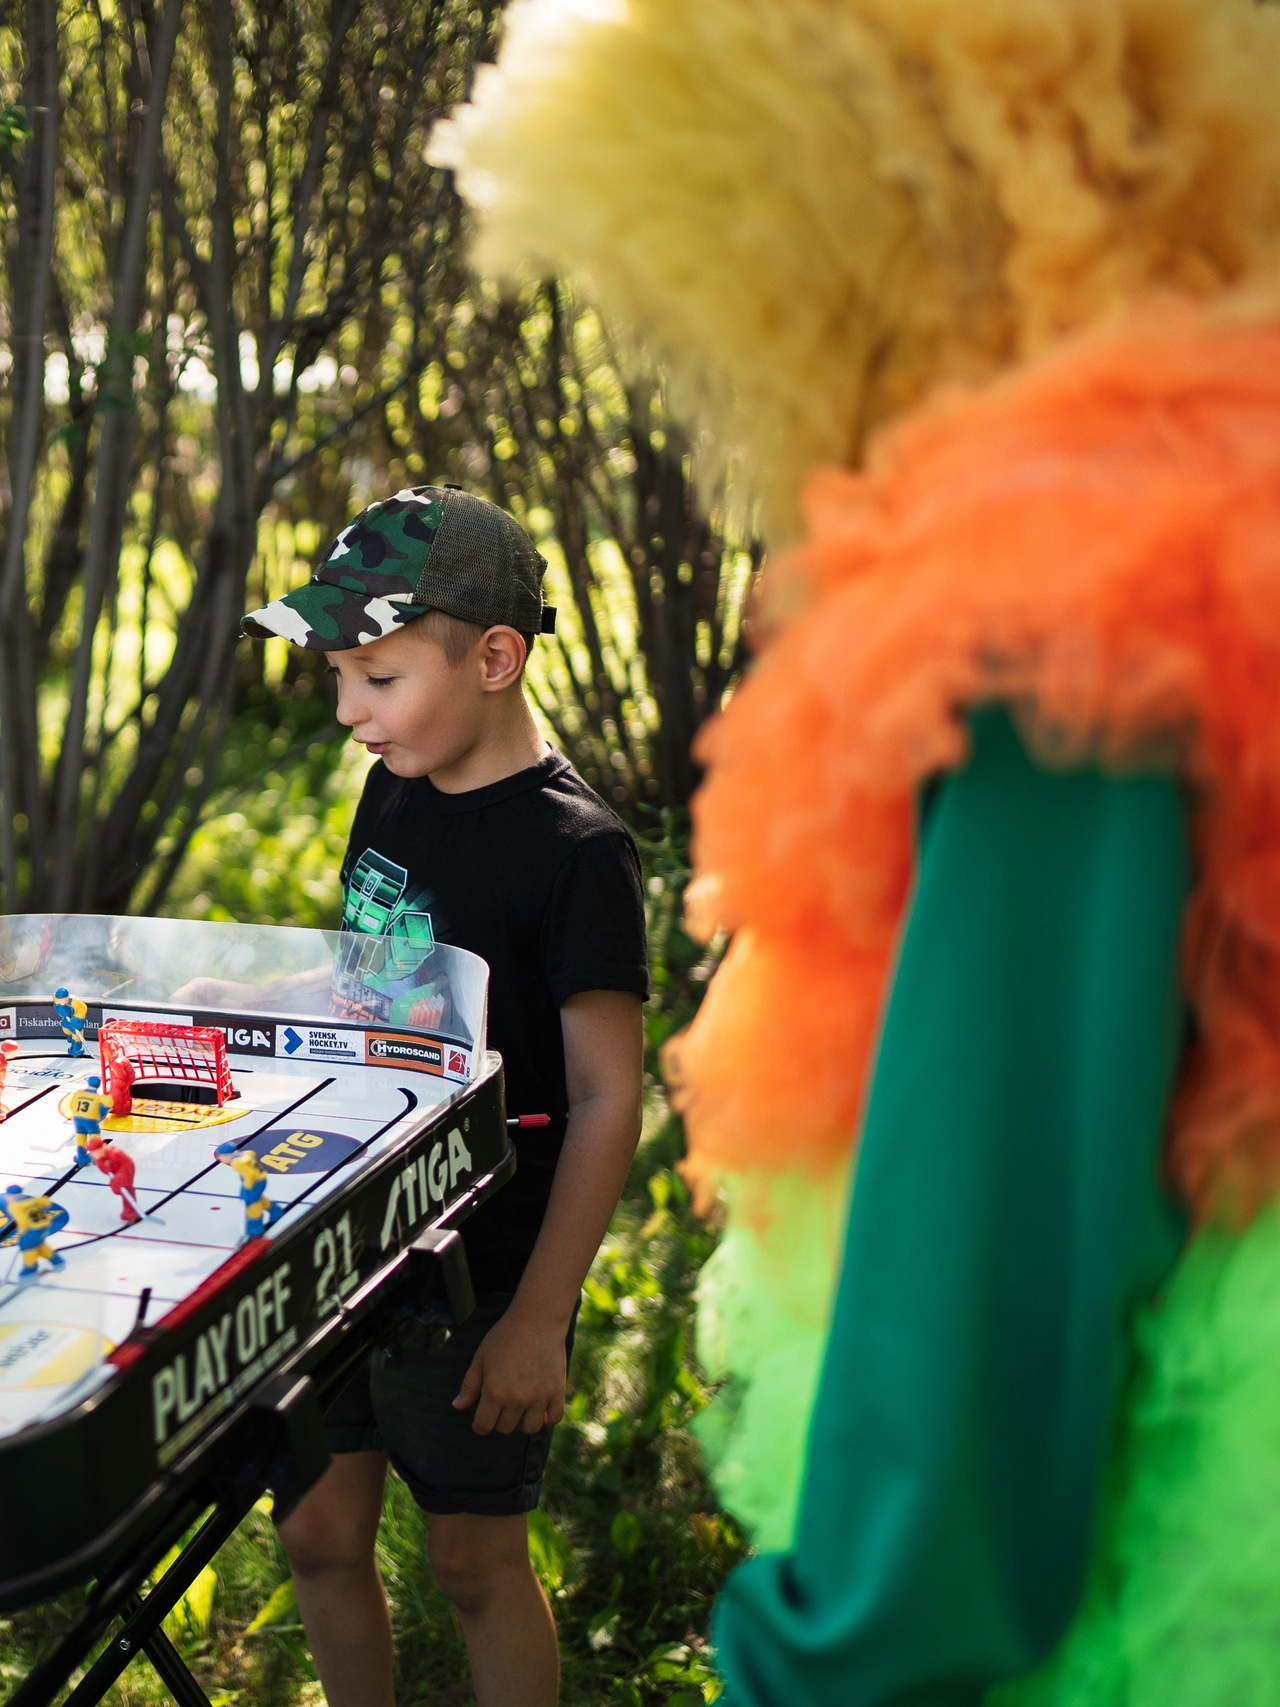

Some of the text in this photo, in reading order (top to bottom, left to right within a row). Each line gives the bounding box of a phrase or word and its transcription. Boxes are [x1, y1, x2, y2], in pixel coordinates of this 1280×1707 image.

[309, 1031, 337, 1040] SVENSK
[309, 1039, 348, 1049] HOCKEY.TV
[377, 1042, 440, 1060] HYDROSCAND
[76, 1101, 90, 1113] 13
[260, 1132, 324, 1172] ATG
[380, 1127, 472, 1252] STIGA
[314, 1209, 360, 1319] 21
